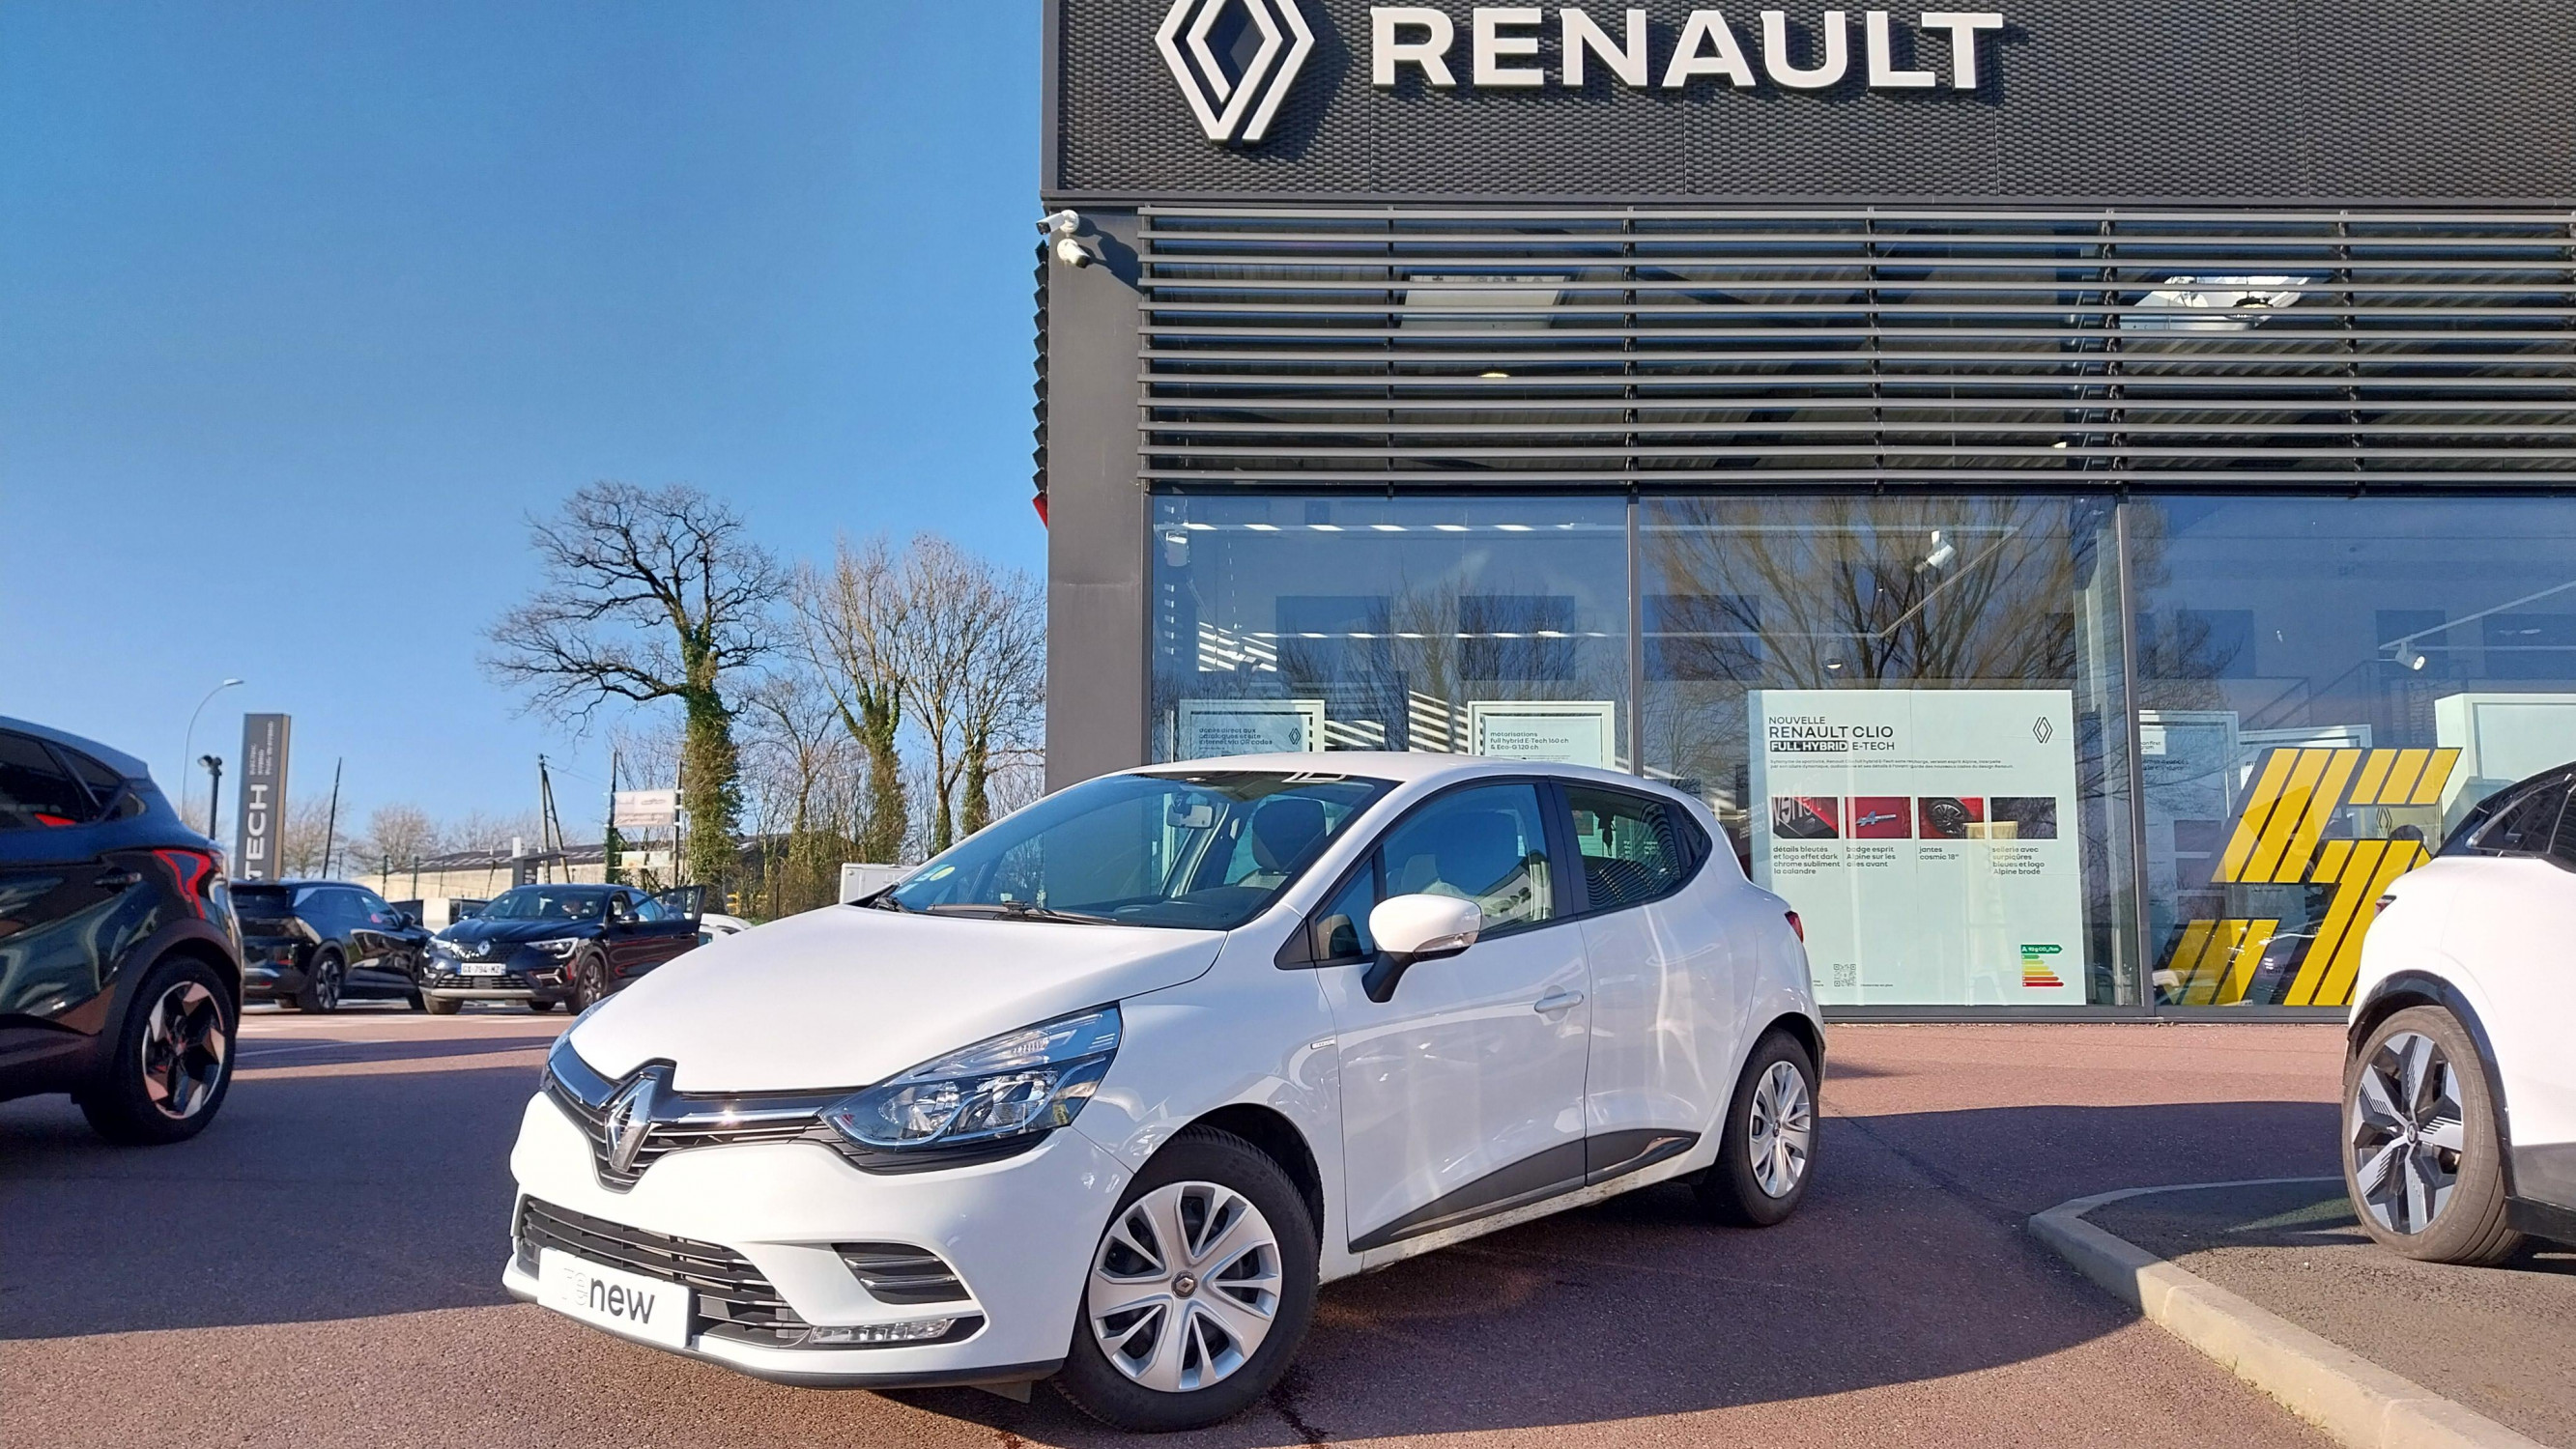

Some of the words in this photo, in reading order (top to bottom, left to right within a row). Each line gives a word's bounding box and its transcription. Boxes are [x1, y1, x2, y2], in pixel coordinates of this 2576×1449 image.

[1370, 7, 2003, 89] RENAULT
[1768, 716, 1826, 724] NOUVELLE
[1769, 725, 1849, 739] RENAULT
[1852, 725, 1894, 738] CLIO
[1771, 741, 1800, 752] FULL
[1803, 741, 1847, 752] HYBRID
[1852, 741, 1895, 751] E-TECH
[244, 783, 269, 881] TECH
[1872, 845, 1895, 854] esprit
[1919, 845, 1943, 854] jantes
